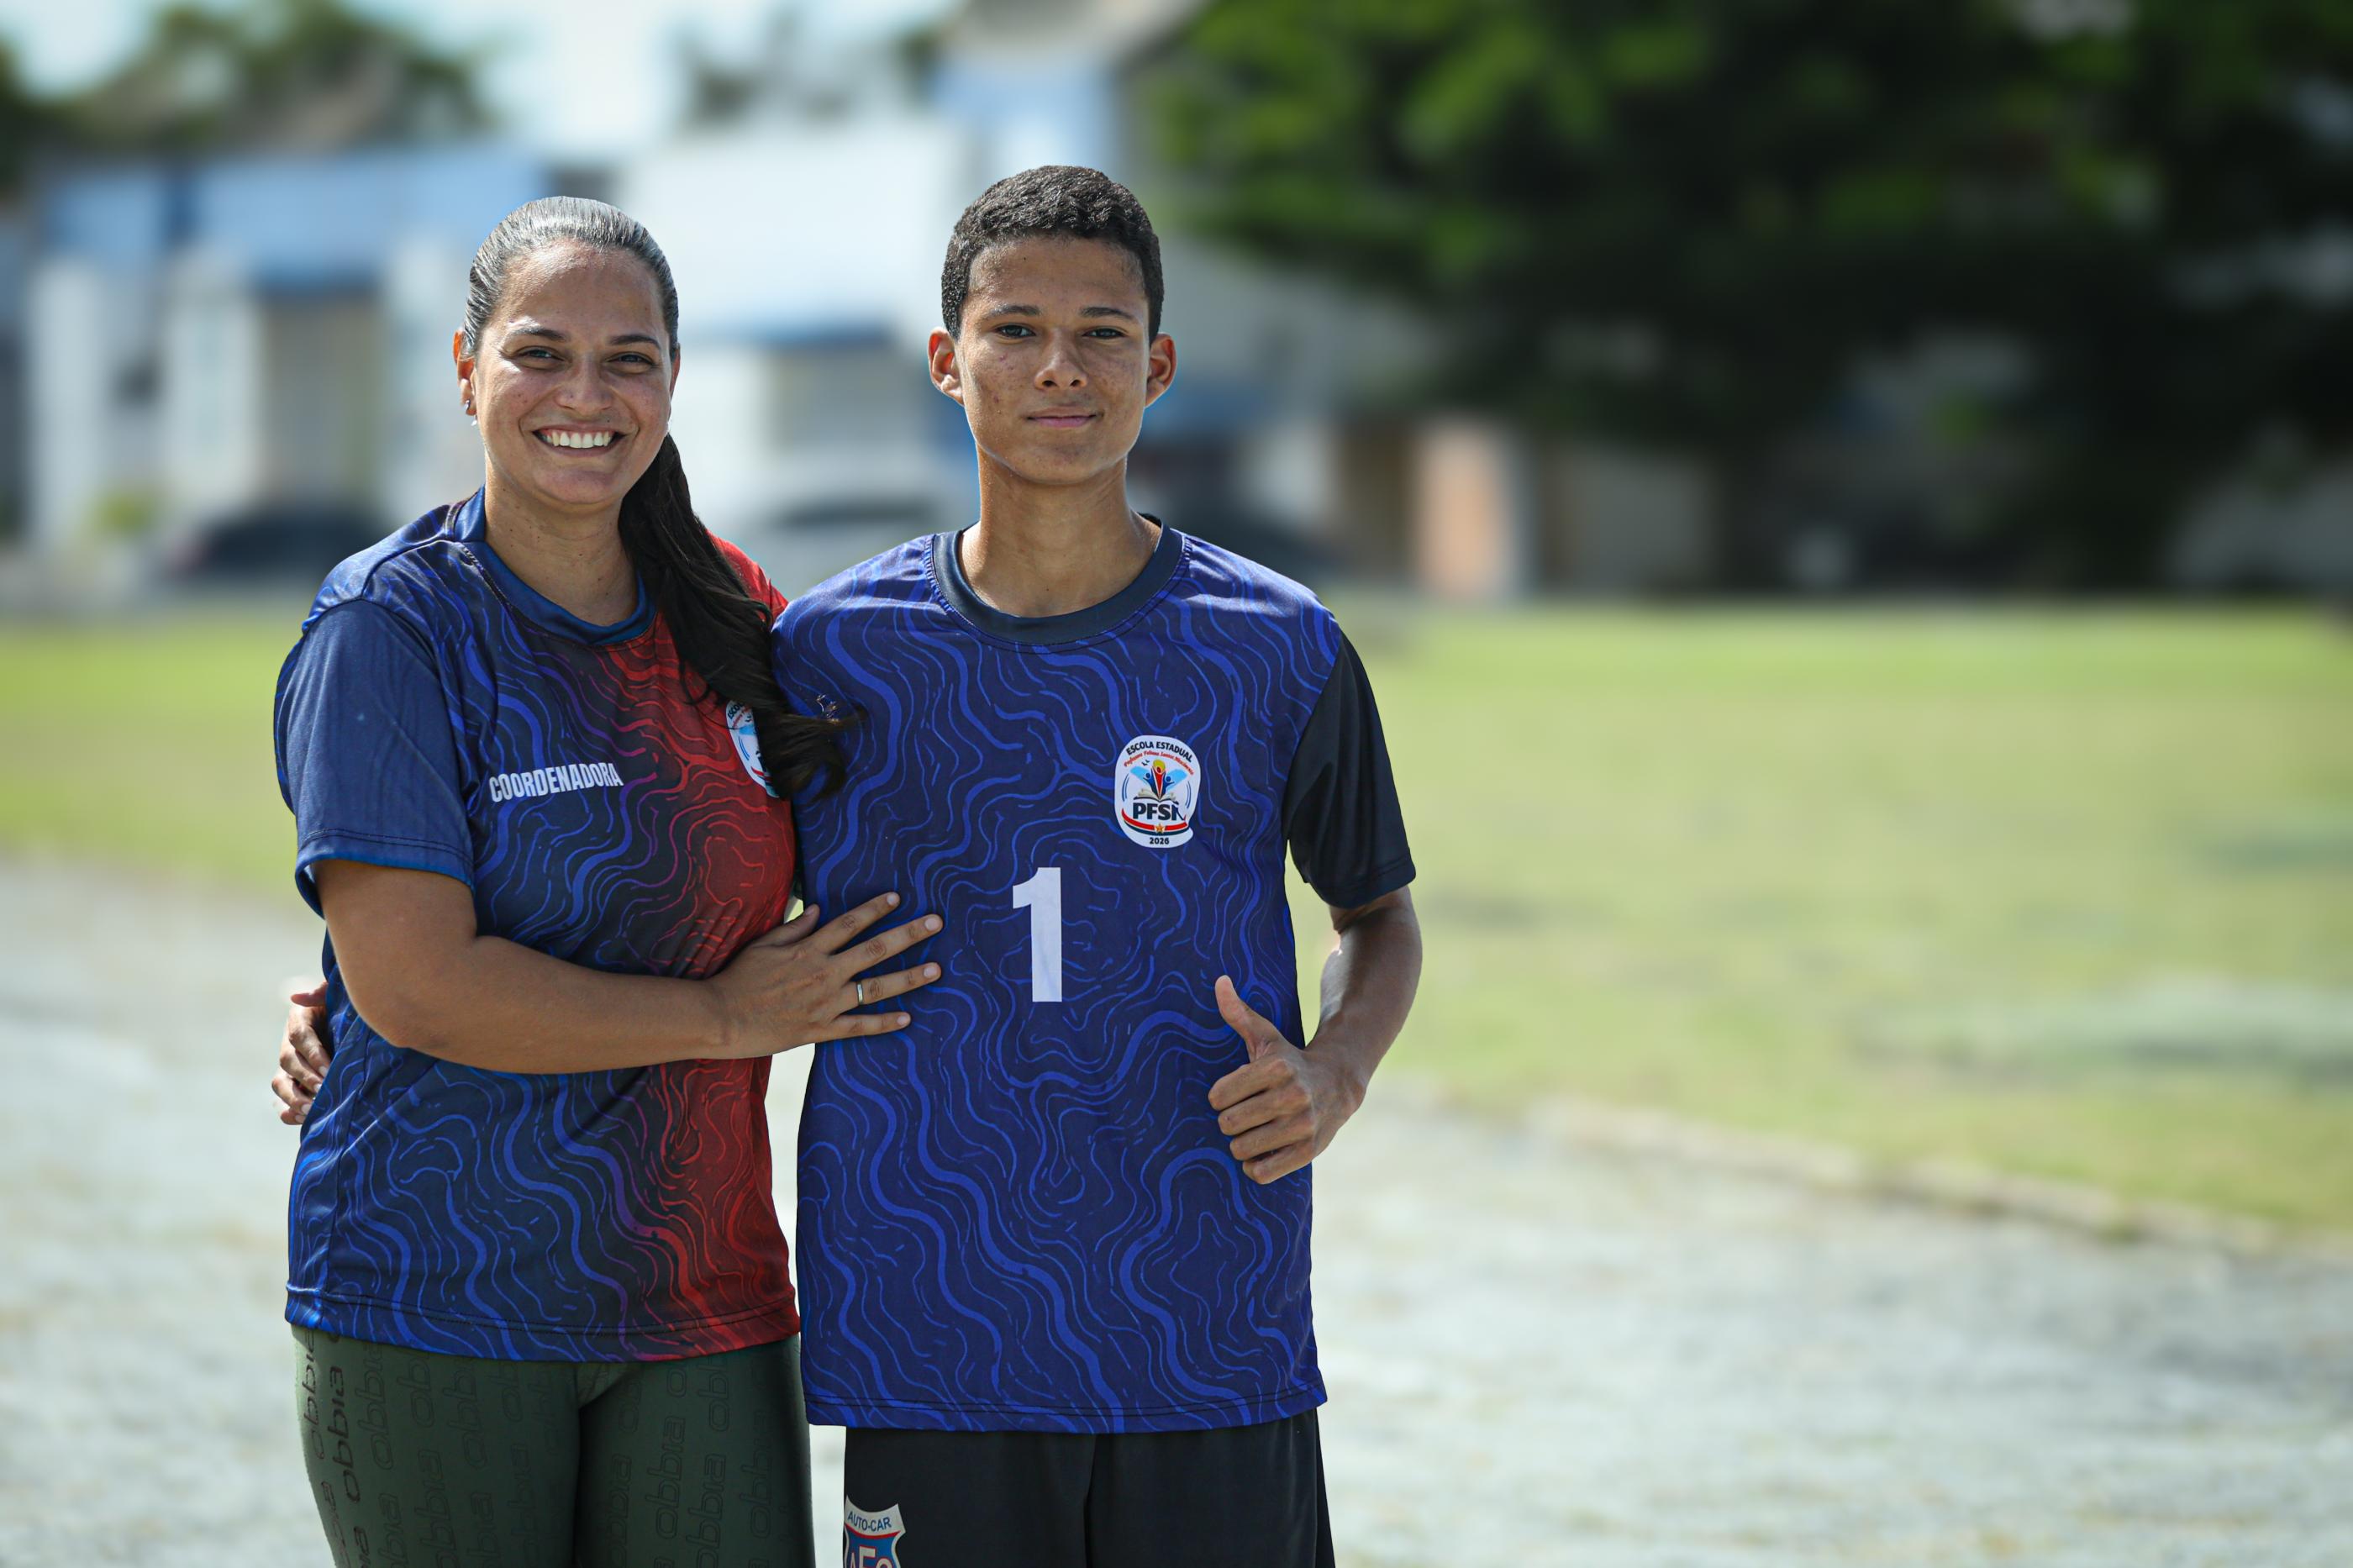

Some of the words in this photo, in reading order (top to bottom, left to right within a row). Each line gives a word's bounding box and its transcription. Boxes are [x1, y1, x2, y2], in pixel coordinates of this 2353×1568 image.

[728, 702, 744, 719] ESCO
[1126, 741, 1154, 755] ESCOLA
[1156, 741, 1193, 762] ESTADUAL
[489, 762, 624, 802] COORDENADORA
[1150, 837, 1170, 845] 2026
[1013, 867, 1062, 1002] 1
[848, 1511, 892, 1532] AUTO-CAR
